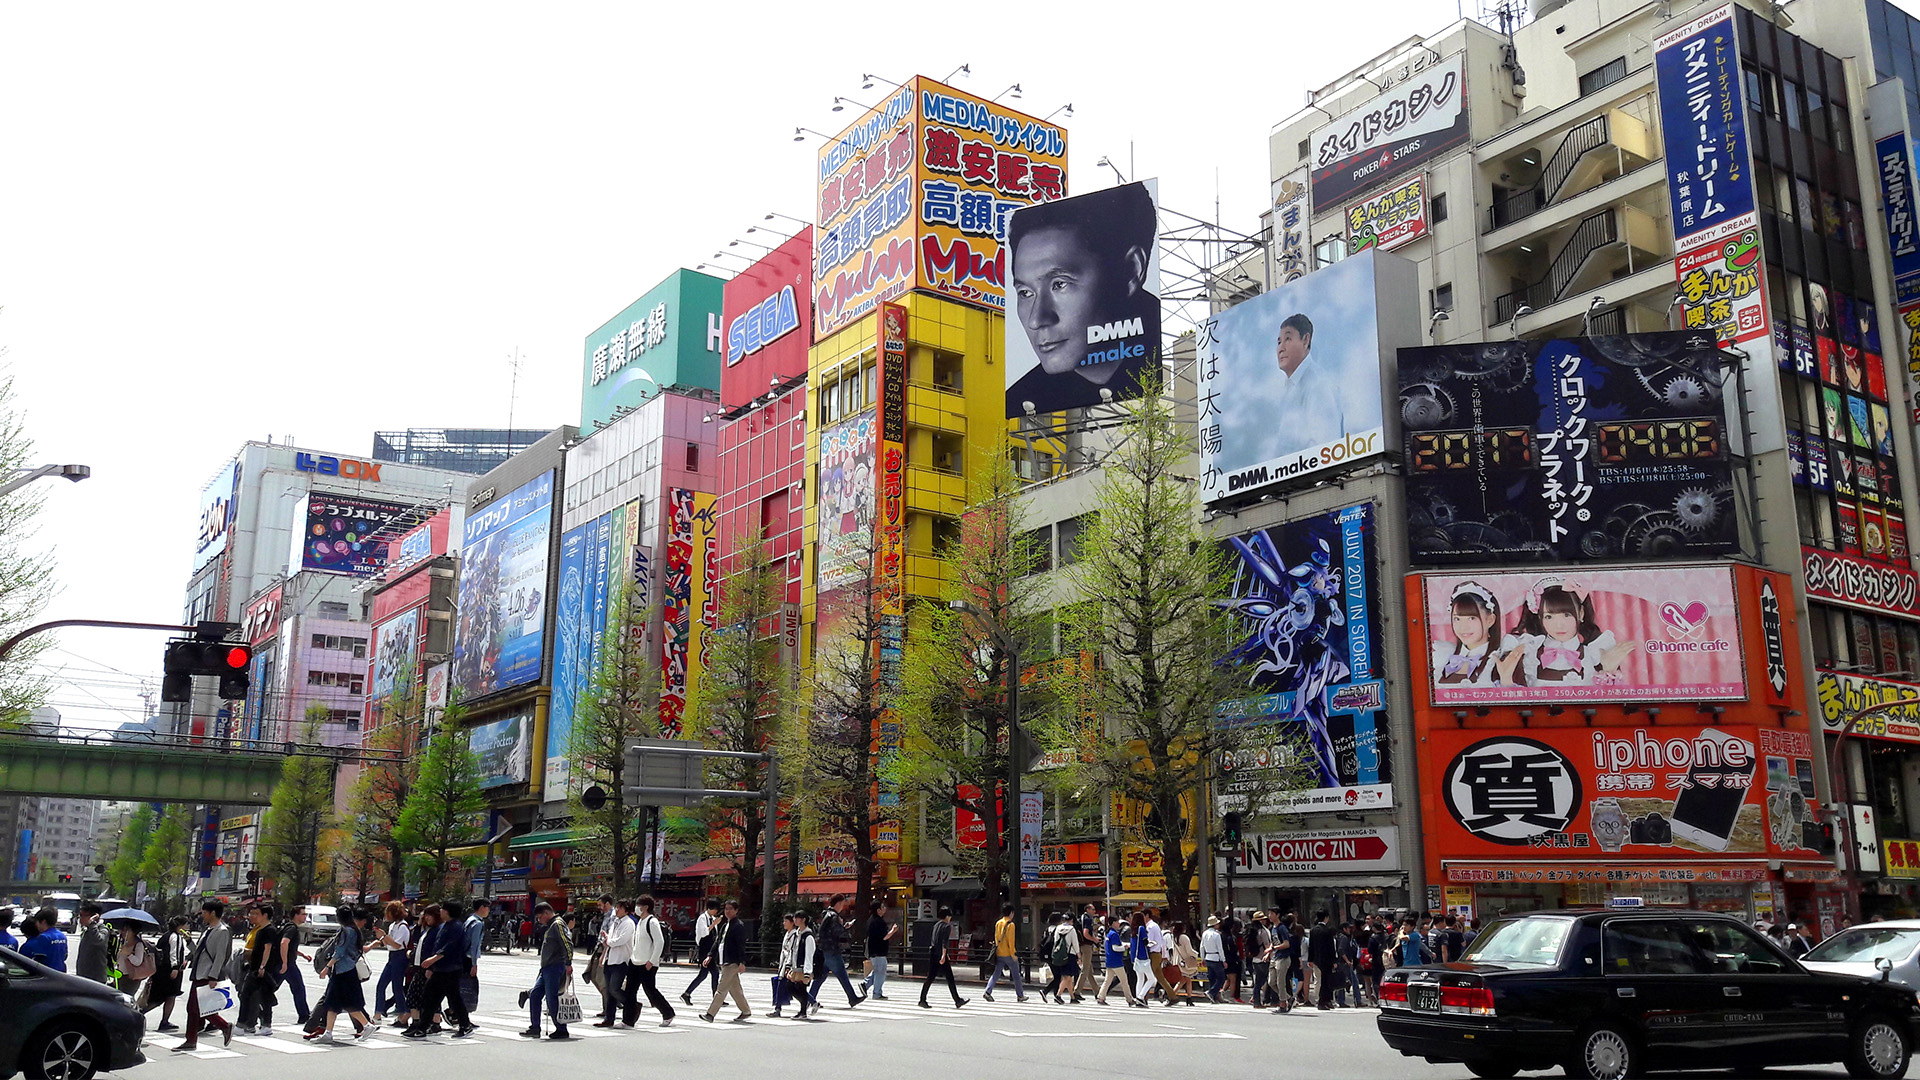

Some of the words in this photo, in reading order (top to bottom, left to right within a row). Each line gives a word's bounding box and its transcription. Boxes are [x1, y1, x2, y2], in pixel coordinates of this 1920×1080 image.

[1658, 26, 1694, 48] AMENITY
[1697, 9, 1727, 29] DREAM
[820, 84, 914, 183] MEDIAリサイクル
[921, 89, 1065, 158] MEDIAリサイクル
[1317, 71, 1456, 167] メイドカジノ
[820, 121, 915, 227] 激安販売
[922, 126, 1064, 201] 激安販売
[1353, 161, 1380, 181] POKER
[1392, 139, 1420, 161] STARS
[1350, 181, 1421, 231] まんが喫茶
[1676, 170, 1695, 228] 秋葉原店
[818, 173, 912, 279] 高額買取
[1680, 229, 1716, 249] AMENITY
[1721, 216, 1752, 234] DREAM
[937, 278, 982, 298] ムーラン
[982, 293, 1005, 307] AKIB
[1681, 267, 1759, 304] まんが
[853, 300, 875, 318] AKIBA
[1686, 299, 1732, 328] 喫茶
[1741, 316, 1760, 329] 3F
[727, 285, 801, 367] SEGA
[1087, 316, 1144, 345] DMM
[590, 301, 667, 387] 廣瀬無線
[885, 352, 903, 364] DVD
[1080, 341, 1146, 366] .make
[885, 373, 903, 383] ゲーム
[888, 382, 900, 392] CD
[884, 402, 903, 412] アニメ
[1197, 318, 1225, 500] 次は太陽か。
[1320, 432, 1377, 466] solar
[1414, 431, 1530, 471] 2017
[1808, 459, 1828, 487] 5F
[467, 499, 511, 541] ソフマップ
[1334, 510, 1367, 525] VERTEX
[1345, 530, 1359, 561] JULY
[631, 549, 649, 606] AKKY
[1346, 564, 1362, 598] 2017
[1805, 552, 1916, 611] メイドカジノ
[1350, 604, 1364, 620] IN
[1351, 624, 1369, 679] STORE!!
[1700, 638, 1730, 652] cafe
[1591, 728, 1748, 774] iphone
[1459, 750, 1570, 833] 質
[1596, 773, 1655, 791] 携帯
[1665, 772, 1753, 791] スマホ
[1312, 796, 1325, 806] and
[1325, 796, 1341, 805] more
[878, 830, 899, 842] AKIBA
[969, 823, 987, 832] mobil
[1536, 832, 1590, 849] 大黒屋
[1268, 841, 1326, 861] COMIC
[1330, 839, 1356, 859] ZIN
[919, 869, 950, 884] ラーメン
[1267, 862, 1317, 872] Akihabara
[1449, 868, 1494, 882] 高価買取
[1719, 868, 1767, 881] 無料査定
[1673, 1016, 1687, 1024] 127
[1723, 1013, 1764, 1022] CHUO-TAXI
